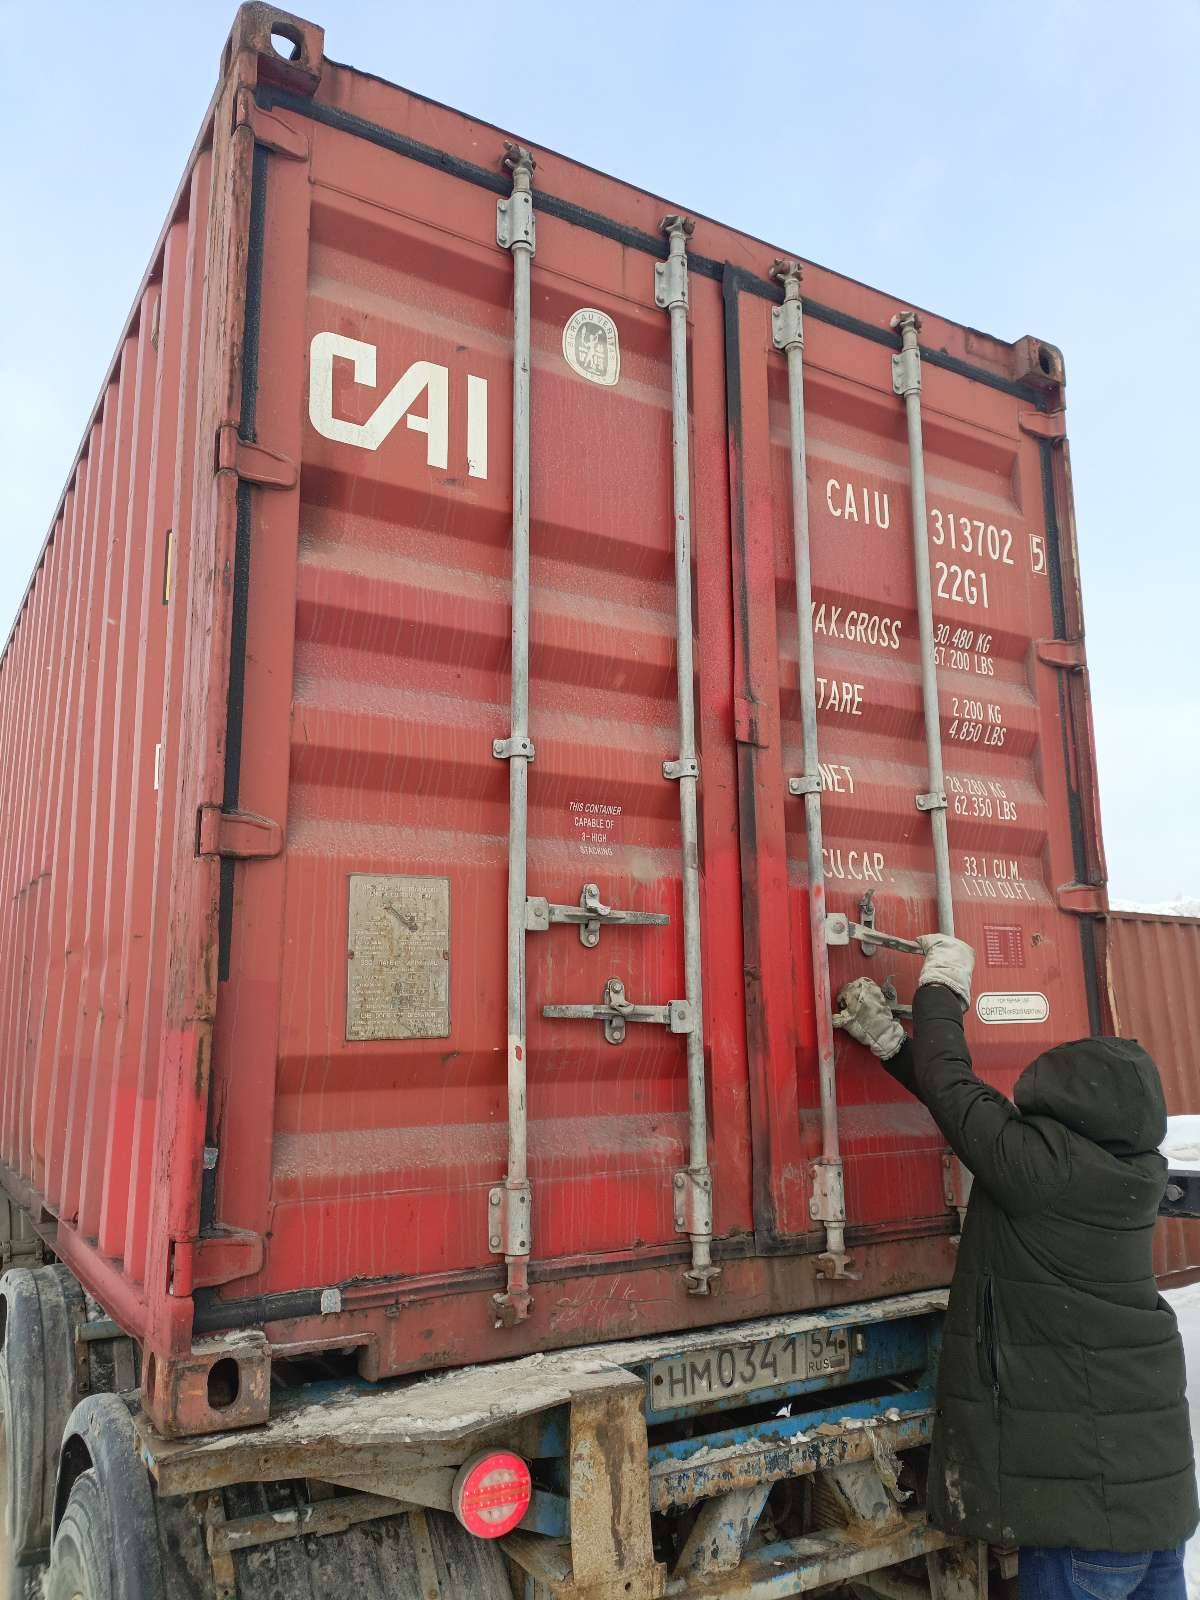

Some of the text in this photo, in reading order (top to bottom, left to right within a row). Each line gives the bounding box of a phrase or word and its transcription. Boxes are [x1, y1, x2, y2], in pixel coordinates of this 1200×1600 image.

[309, 331, 488, 480] CAI
[826, 479, 890, 529] CAIU
[930, 509, 1044, 571] 313702 5
[935, 561, 989, 609] 22G1
[975, 633, 993, 654] KG
[974, 655, 994, 677] LBS
[816, 677, 865, 716] TARE
[987, 703, 1002, 724] KG
[984, 725, 1007, 747] LBS
[819, 763, 855, 794] NET
[988, 781, 1008, 799] KG
[569, 801, 622, 816] THIS CONTAINER
[996, 799, 1018, 821] LBS
[574, 816, 615, 830] CAPABLE OF
[963, 856, 1023, 881] 33.1 CU.M.
[808, 1358, 829, 1373] RUS
